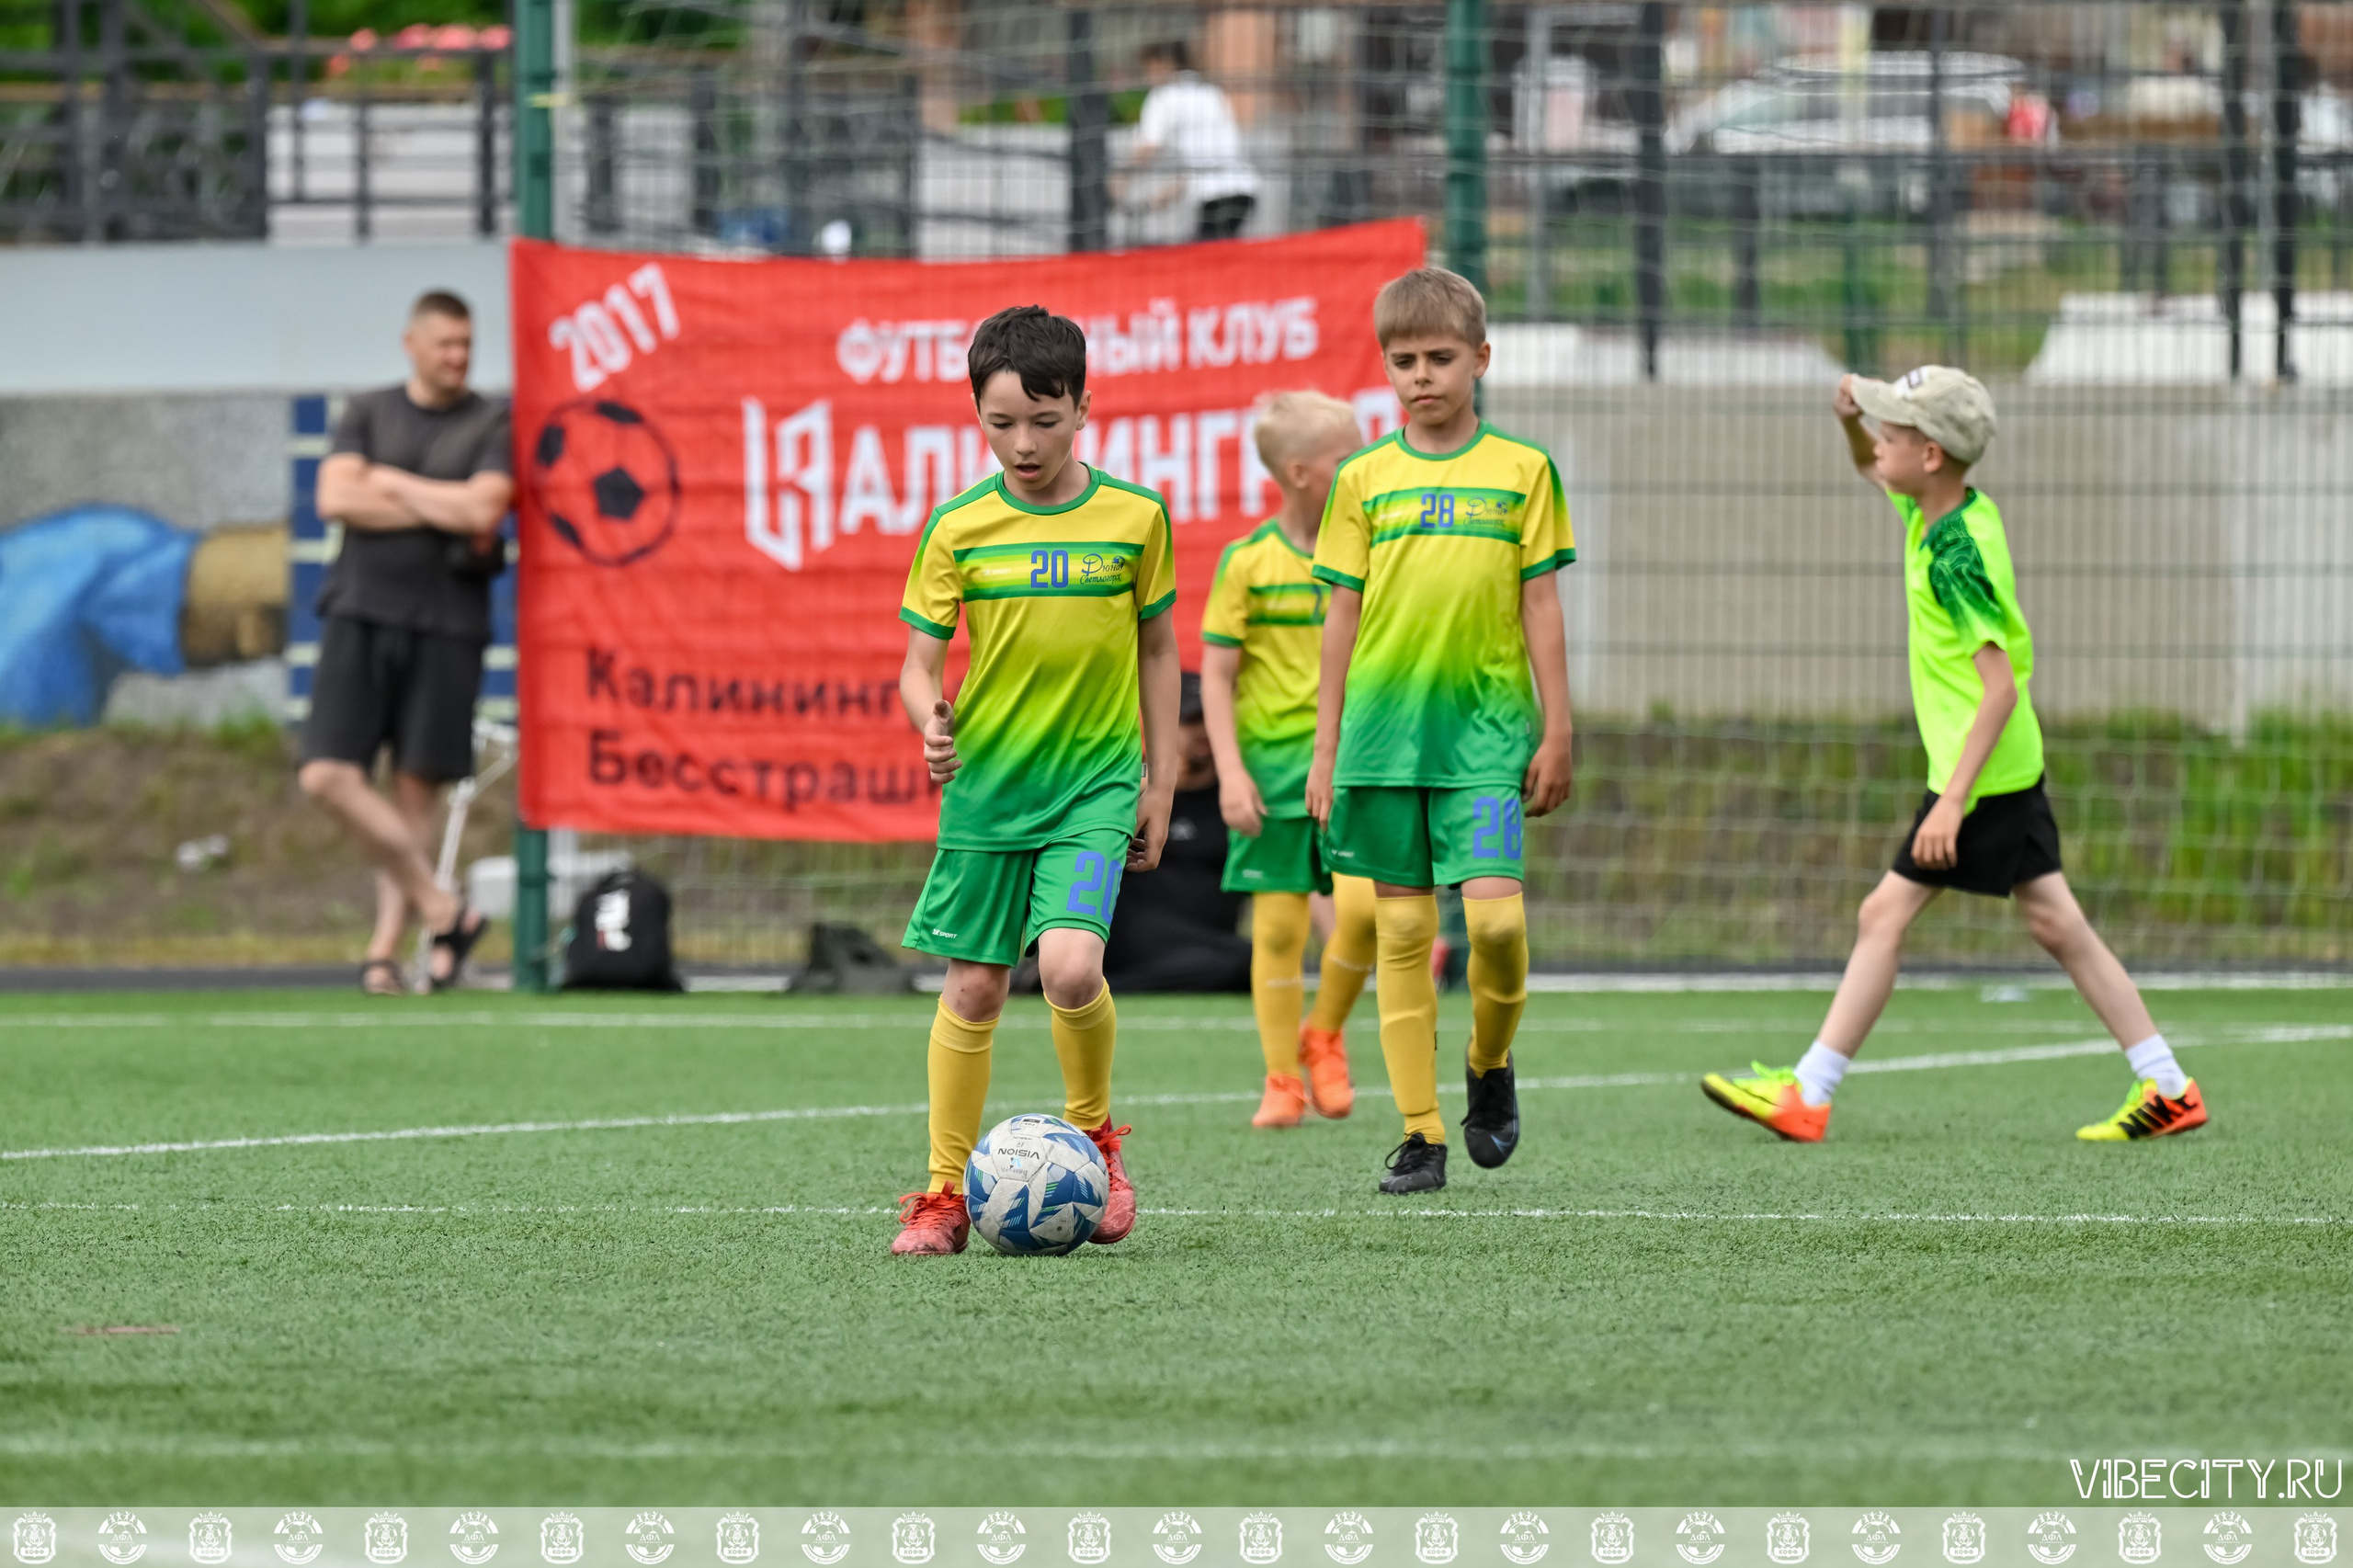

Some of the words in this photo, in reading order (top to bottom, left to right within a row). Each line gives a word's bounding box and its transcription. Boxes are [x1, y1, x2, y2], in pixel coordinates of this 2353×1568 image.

[547, 262, 681, 392] 2017
[1187, 296, 1320, 369] КЛУБ
[1420, 494, 1455, 528] 28
[1030, 550, 1069, 588] 20
[1472, 796, 1522, 860] 28
[997, 1148, 1040, 1160] VISION
